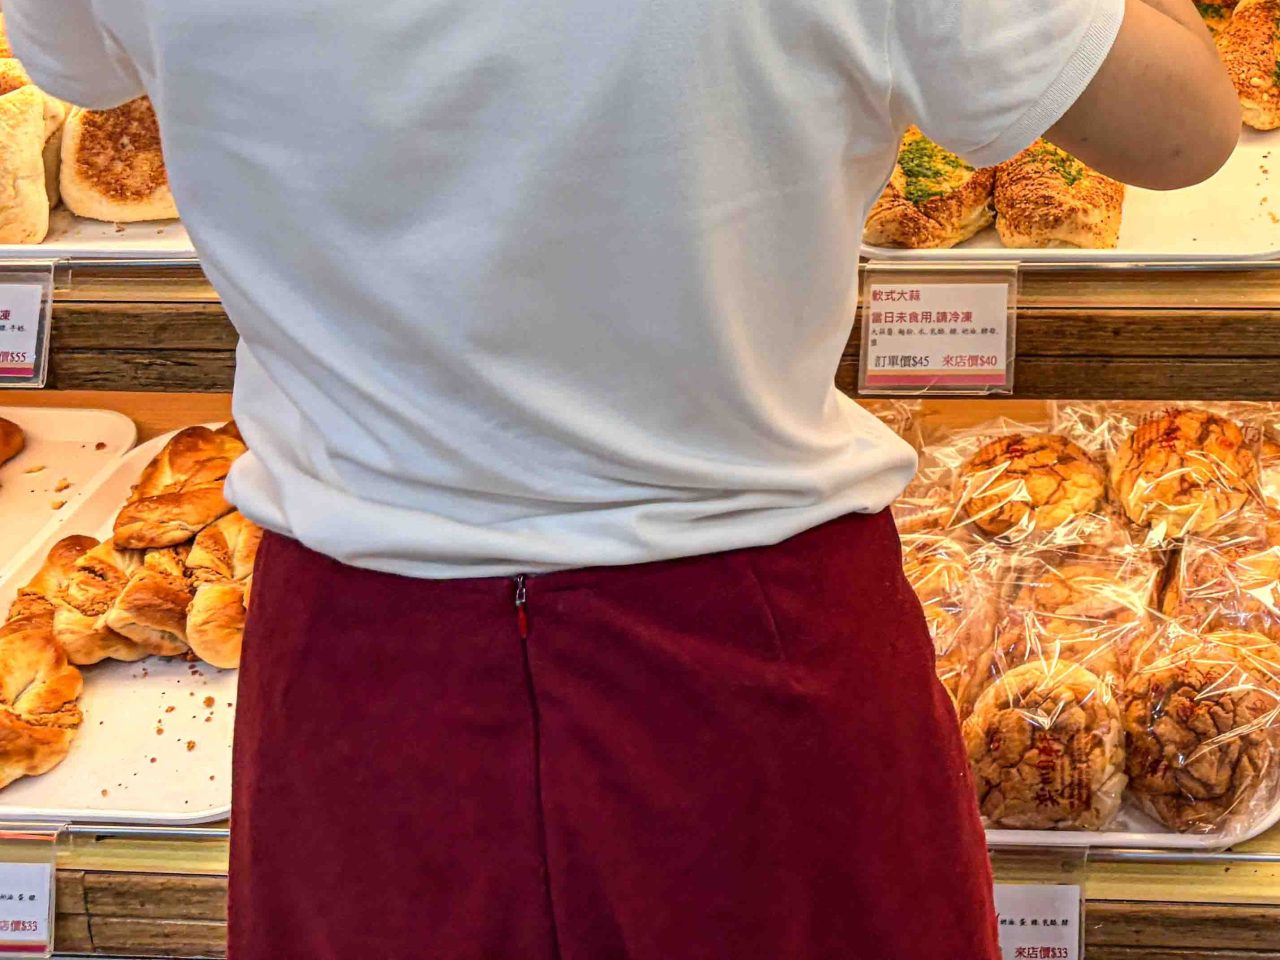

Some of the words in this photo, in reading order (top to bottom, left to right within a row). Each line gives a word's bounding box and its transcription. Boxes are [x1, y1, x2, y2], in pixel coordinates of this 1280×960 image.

[872, 290, 921, 302] 軟式大蒜
[874, 355, 930, 368] 訂單價$45
[943, 355, 998, 368] 來店價$40
